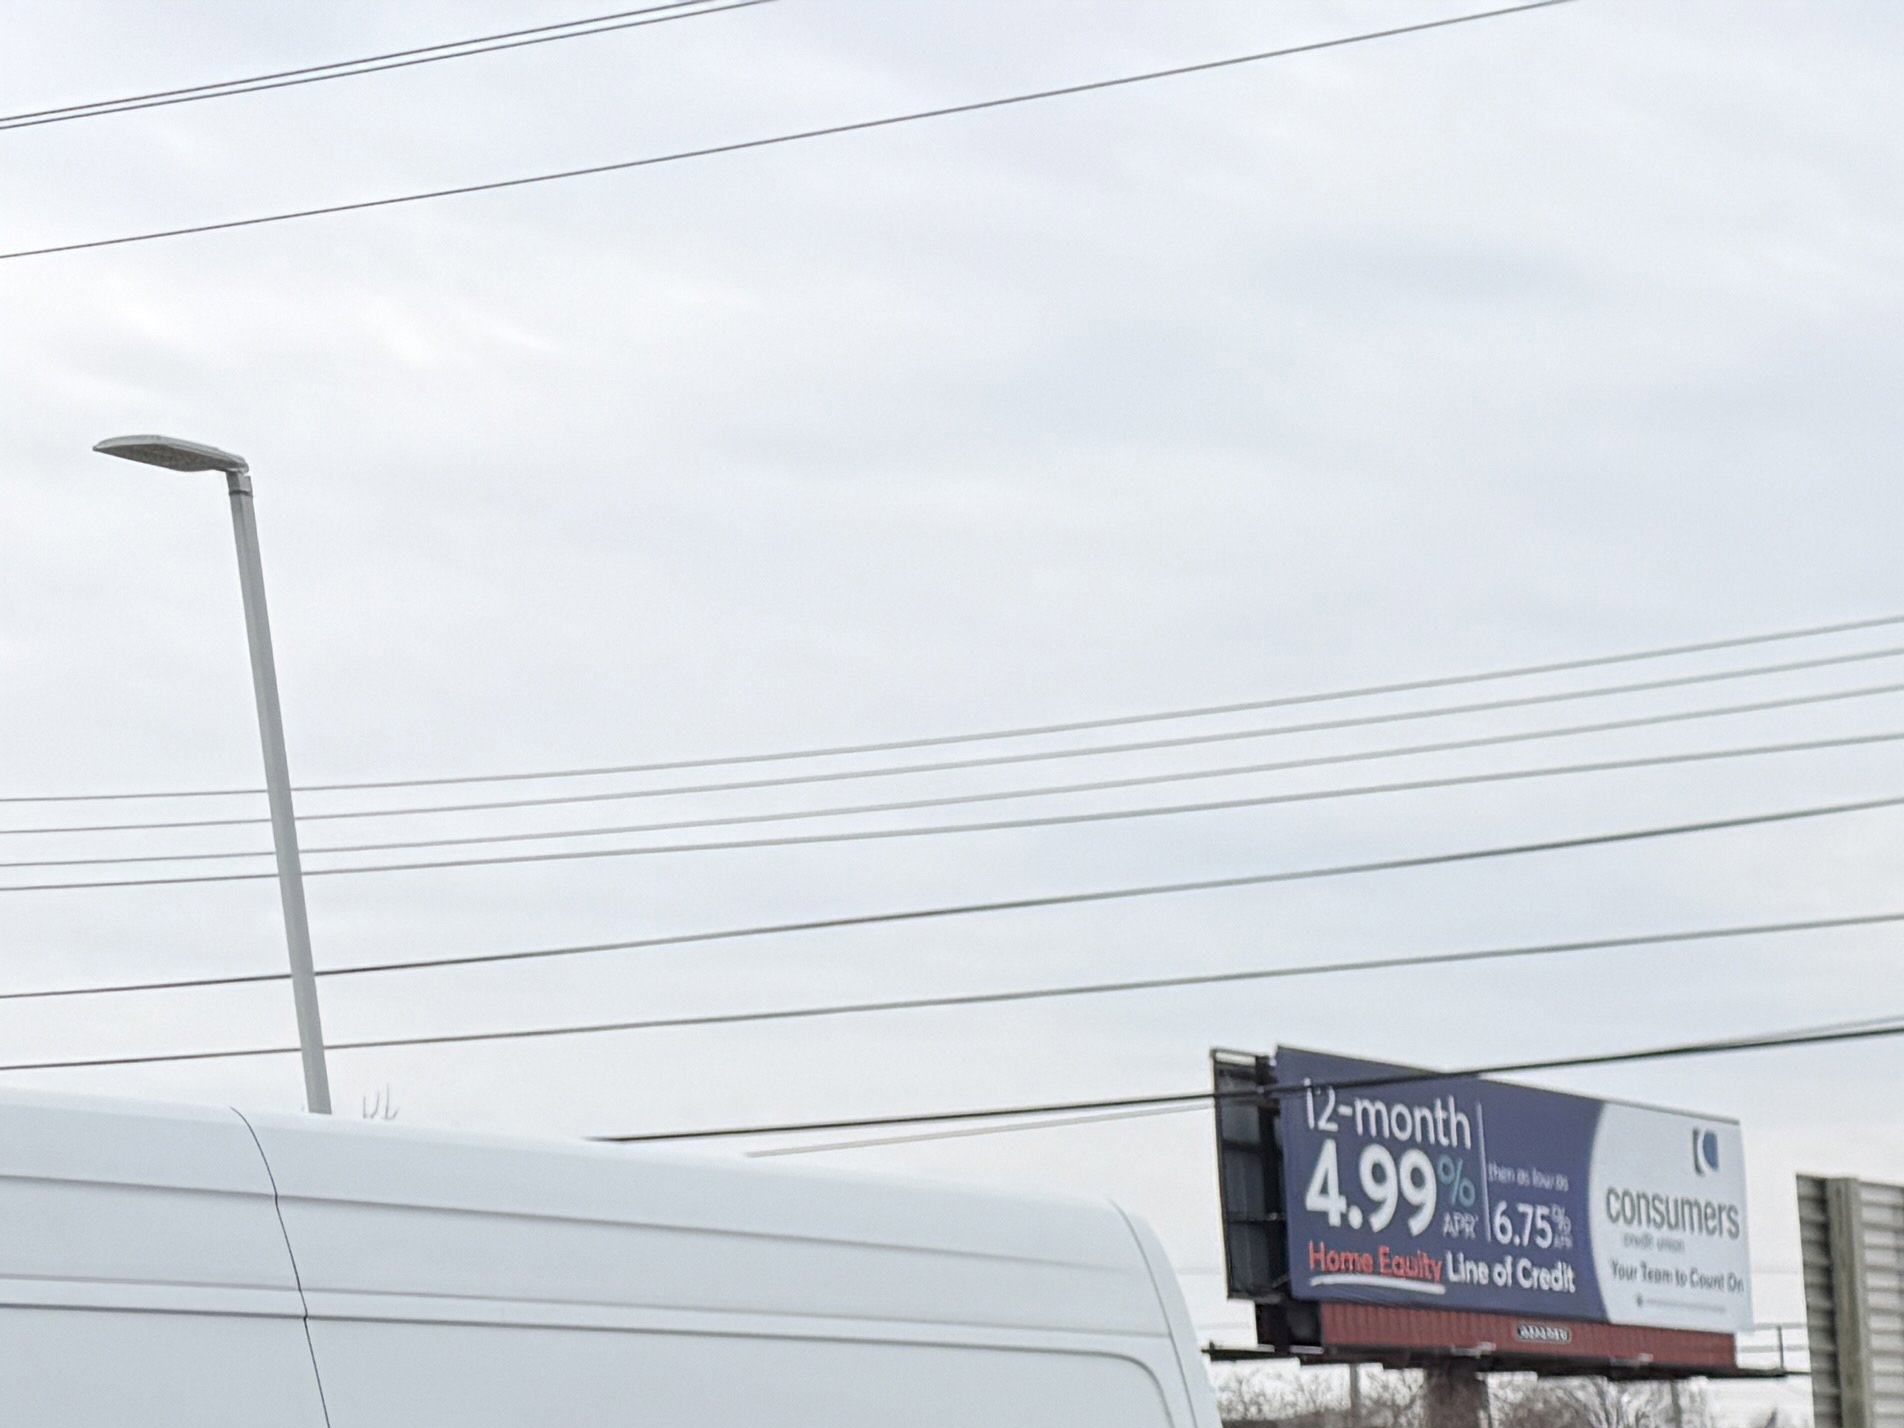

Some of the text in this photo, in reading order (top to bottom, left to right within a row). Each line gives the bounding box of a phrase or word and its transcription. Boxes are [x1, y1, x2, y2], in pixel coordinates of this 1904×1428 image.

[1303, 1077, 1472, 1150] 12-month
[1606, 1186, 1740, 1240] consumers
[1309, 1240, 1576, 1294] Home Equity Line of Credit
[1611, 1257, 1745, 1293] Your Team to Count On
